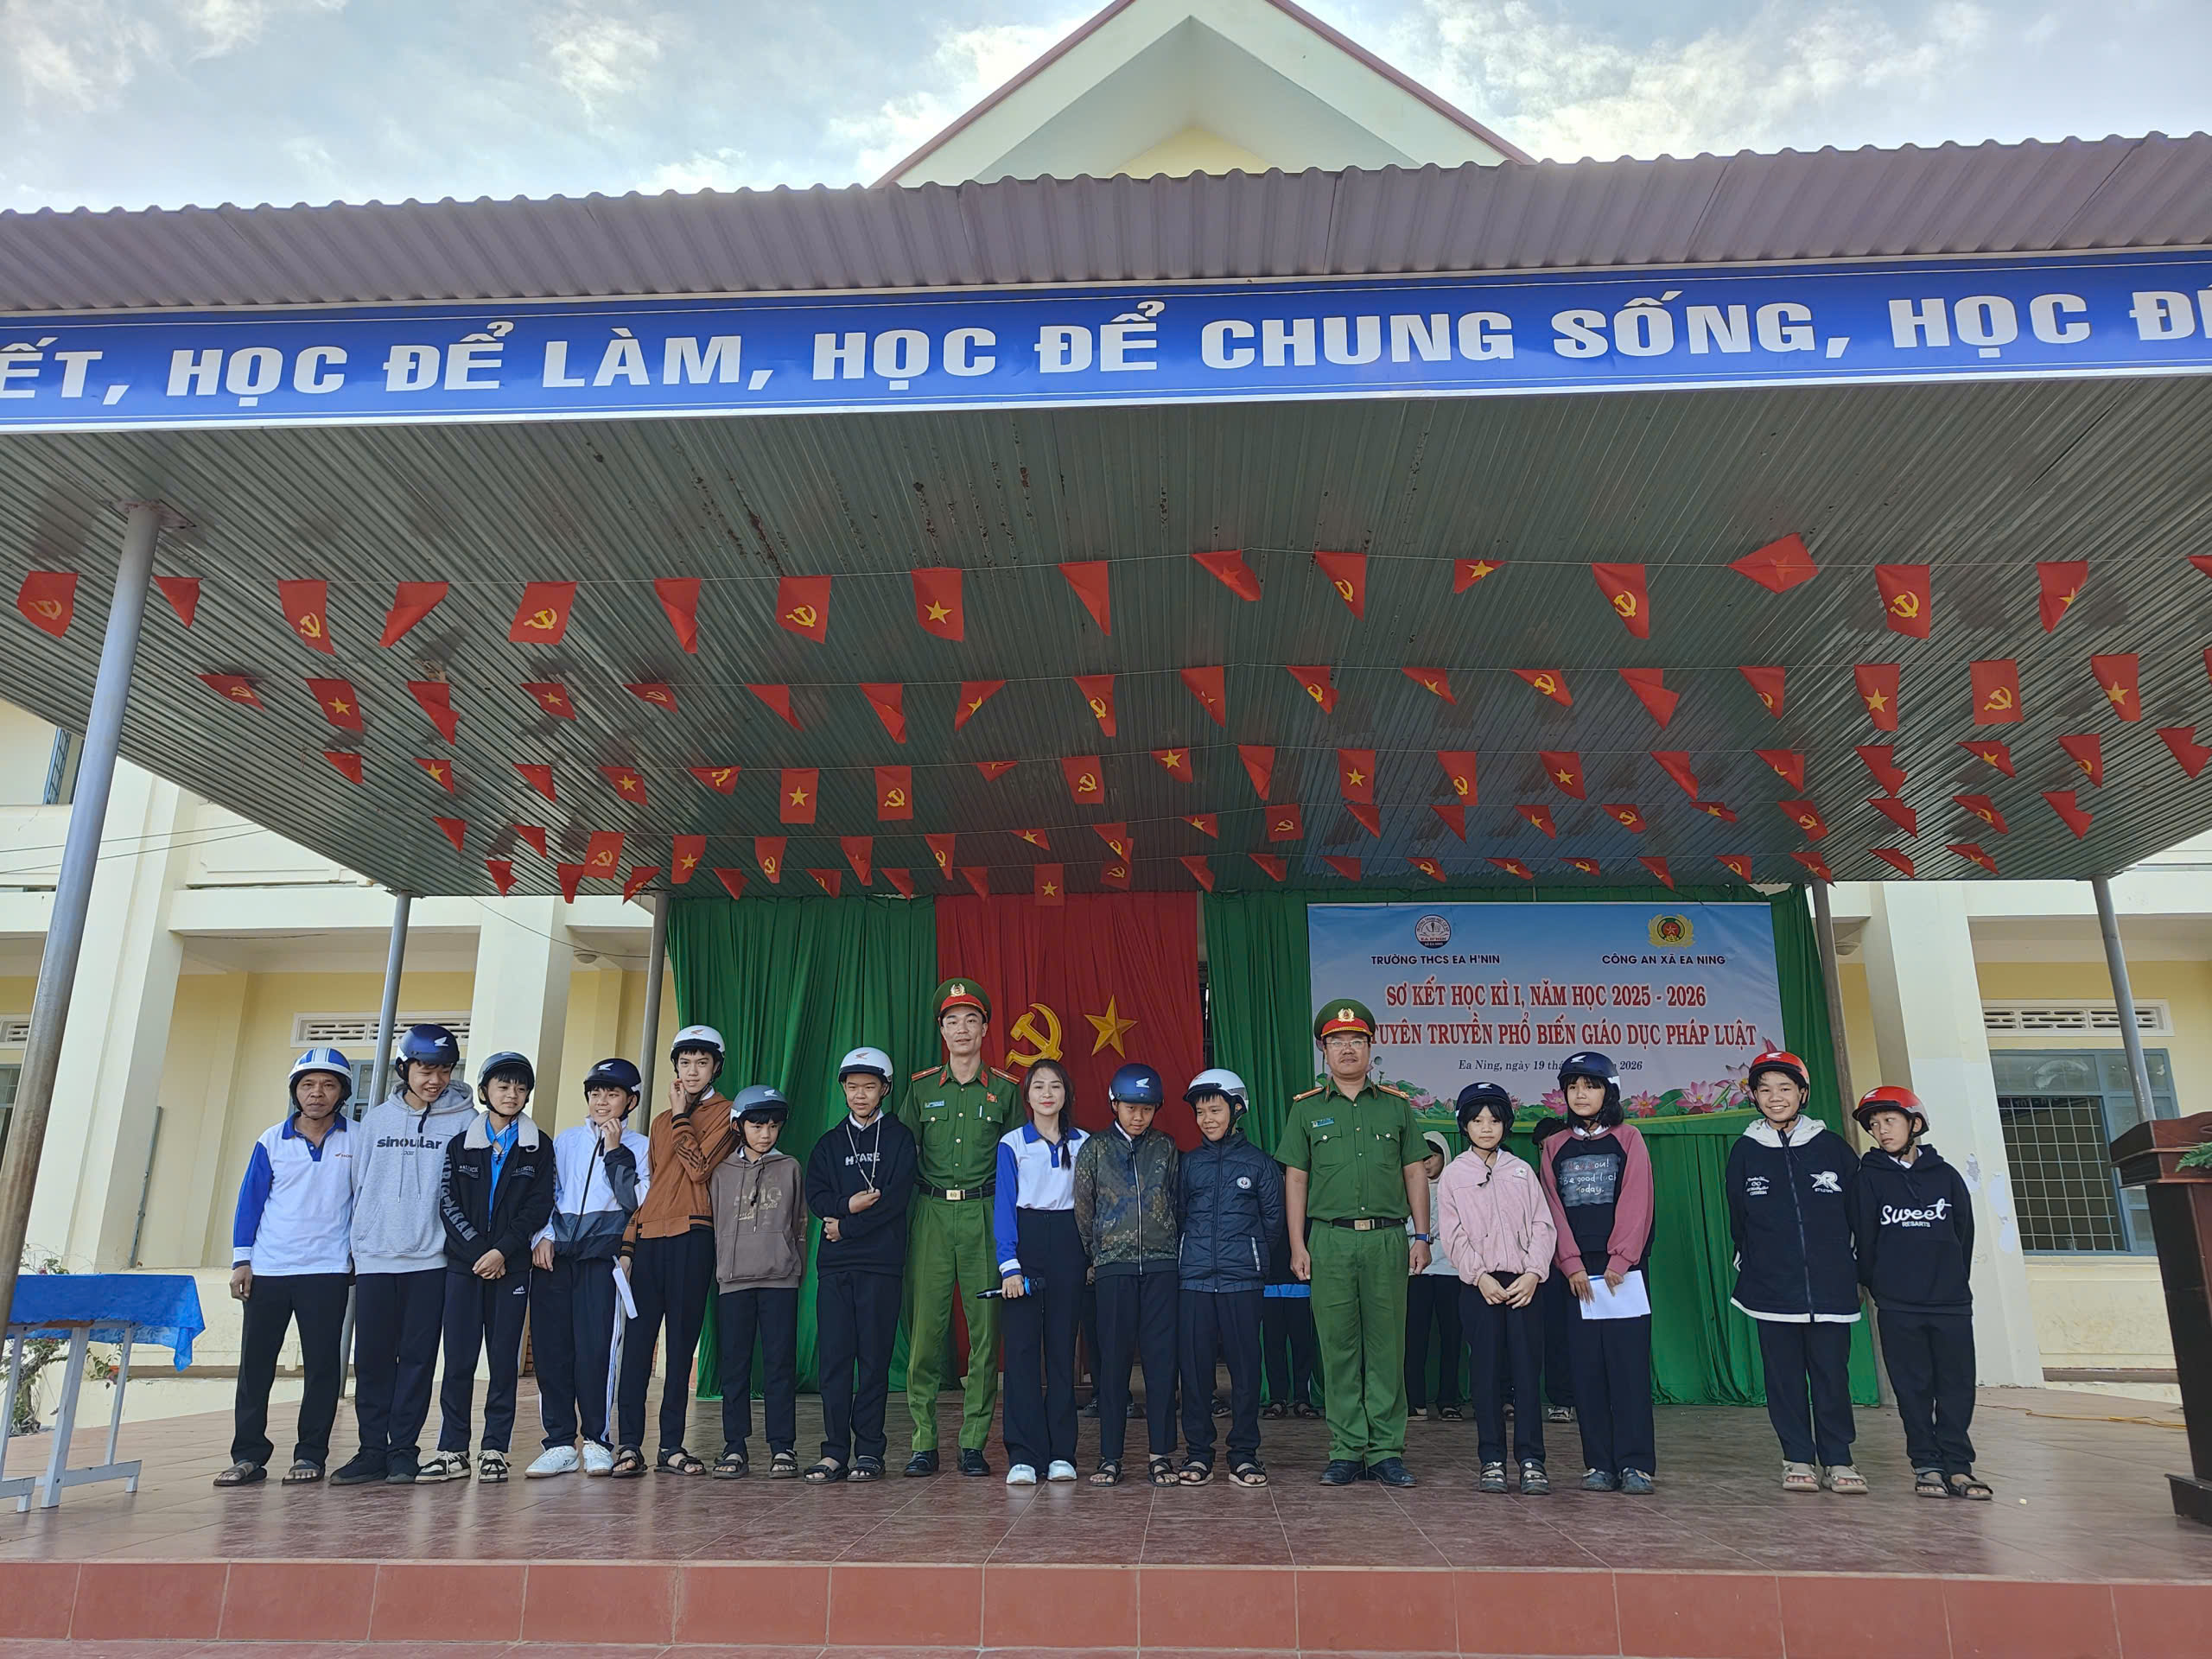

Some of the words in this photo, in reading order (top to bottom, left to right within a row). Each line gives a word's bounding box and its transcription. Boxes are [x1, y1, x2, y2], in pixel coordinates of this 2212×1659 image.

[0, 337, 130, 405] ẾT,
[166, 346, 347, 407] HỌC
[383, 321, 515, 392] ĐỂ
[542, 327, 773, 391] LÀM,
[812, 327, 996, 391] HỌC
[1034, 301, 1166, 373] ĐỂ
[1201, 312, 1514, 369] CHUNG
[1552, 290, 1851, 359] SỐNG,
[1888, 293, 2091, 359] HỌC
[1371, 954, 1417, 965] TRƯỜNG
[1421, 955, 1449, 964] THCS
[1452, 955, 1466, 964] EA
[1470, 955, 1500, 964] H'NIN
[1602, 953, 1637, 964] CÔNG
[1641, 956, 1656, 964] AN
[1660, 954, 1676, 964] XÃ
[1680, 956, 1694, 964] EA
[1697, 956, 1726, 965] NING
[1386, 982, 1408, 1007] SƠ
[1412, 976, 1446, 1006] KẾT
[1451, 985, 1486, 1010] HỌC
[1491, 979, 1510, 1006] KÌ
[1513, 986, 1525, 1008] I,
[1529, 980, 1567, 1006] NĂM
[1572, 986, 1606, 1011] HỌC
[1611, 985, 1651, 1006] 2025
[1667, 986, 1707, 1007] 2026
[1427, 1012, 1492, 1044] TRUYỀN
[1497, 1012, 1531, 1044] PHỔ
[1536, 1014, 1576, 1045] BIẾN
[1581, 1018, 1622, 1045] GIÁO
[1627, 1025, 1661, 1049] DỤC
[1666, 1019, 1709, 1045] PHÁP
[1714, 1019, 1757, 1050] LUẬT
[1459, 1059, 1471, 1070] Ea
[1475, 1059, 1503, 1071] Ning,
[1505, 1060, 1530, 1071] ngày
[1534, 1060, 1545, 1070] 19
[1620, 1060, 1643, 1071] 2026
[1563, 1177, 1574, 1185] Be
[1577, 1173, 1596, 1185] good
[1880, 1198, 1952, 1225] Sweet
